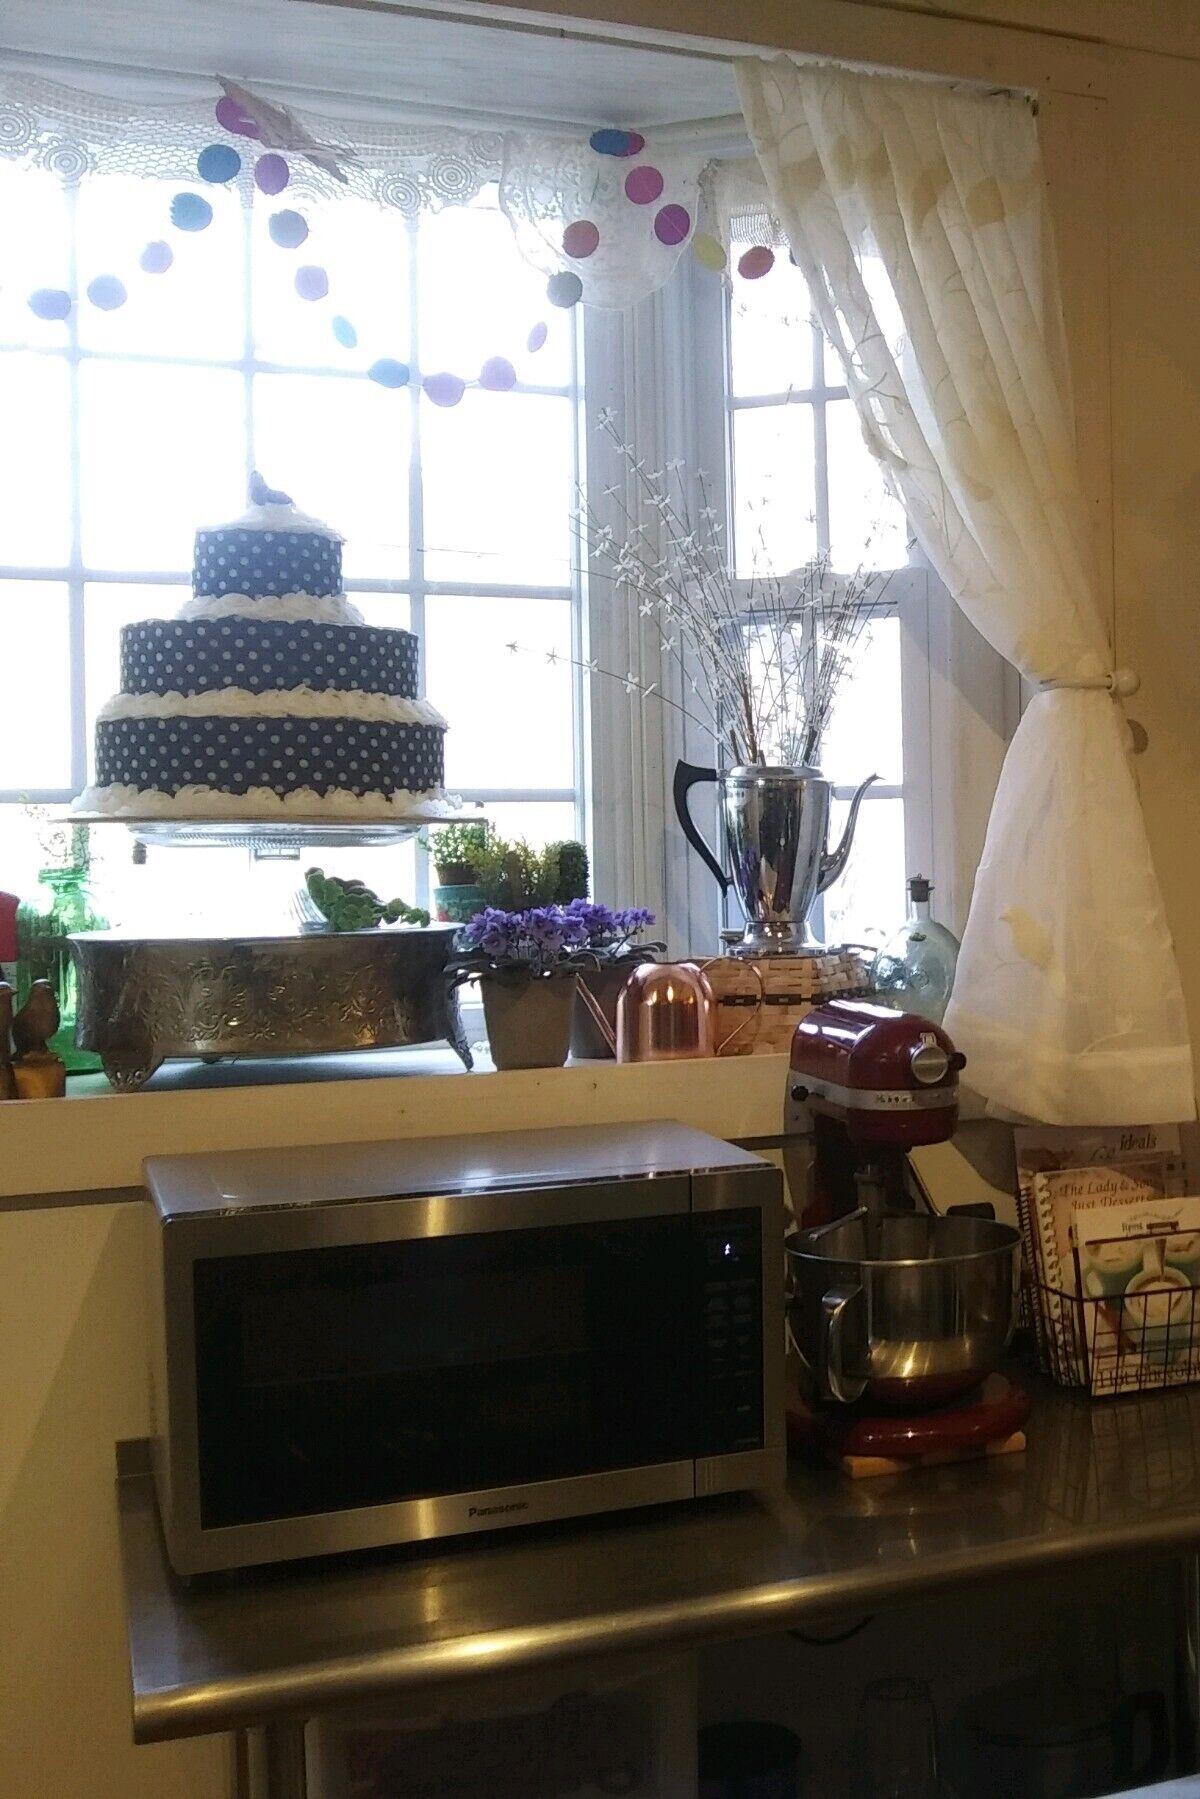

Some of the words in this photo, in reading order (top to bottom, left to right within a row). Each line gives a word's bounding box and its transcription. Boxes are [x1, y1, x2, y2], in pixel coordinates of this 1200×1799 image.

[1059, 1181, 1084, 1197] The
[1088, 1178, 1117, 1196] Lady
[467, 1501, 530, 1518] Panasonic
